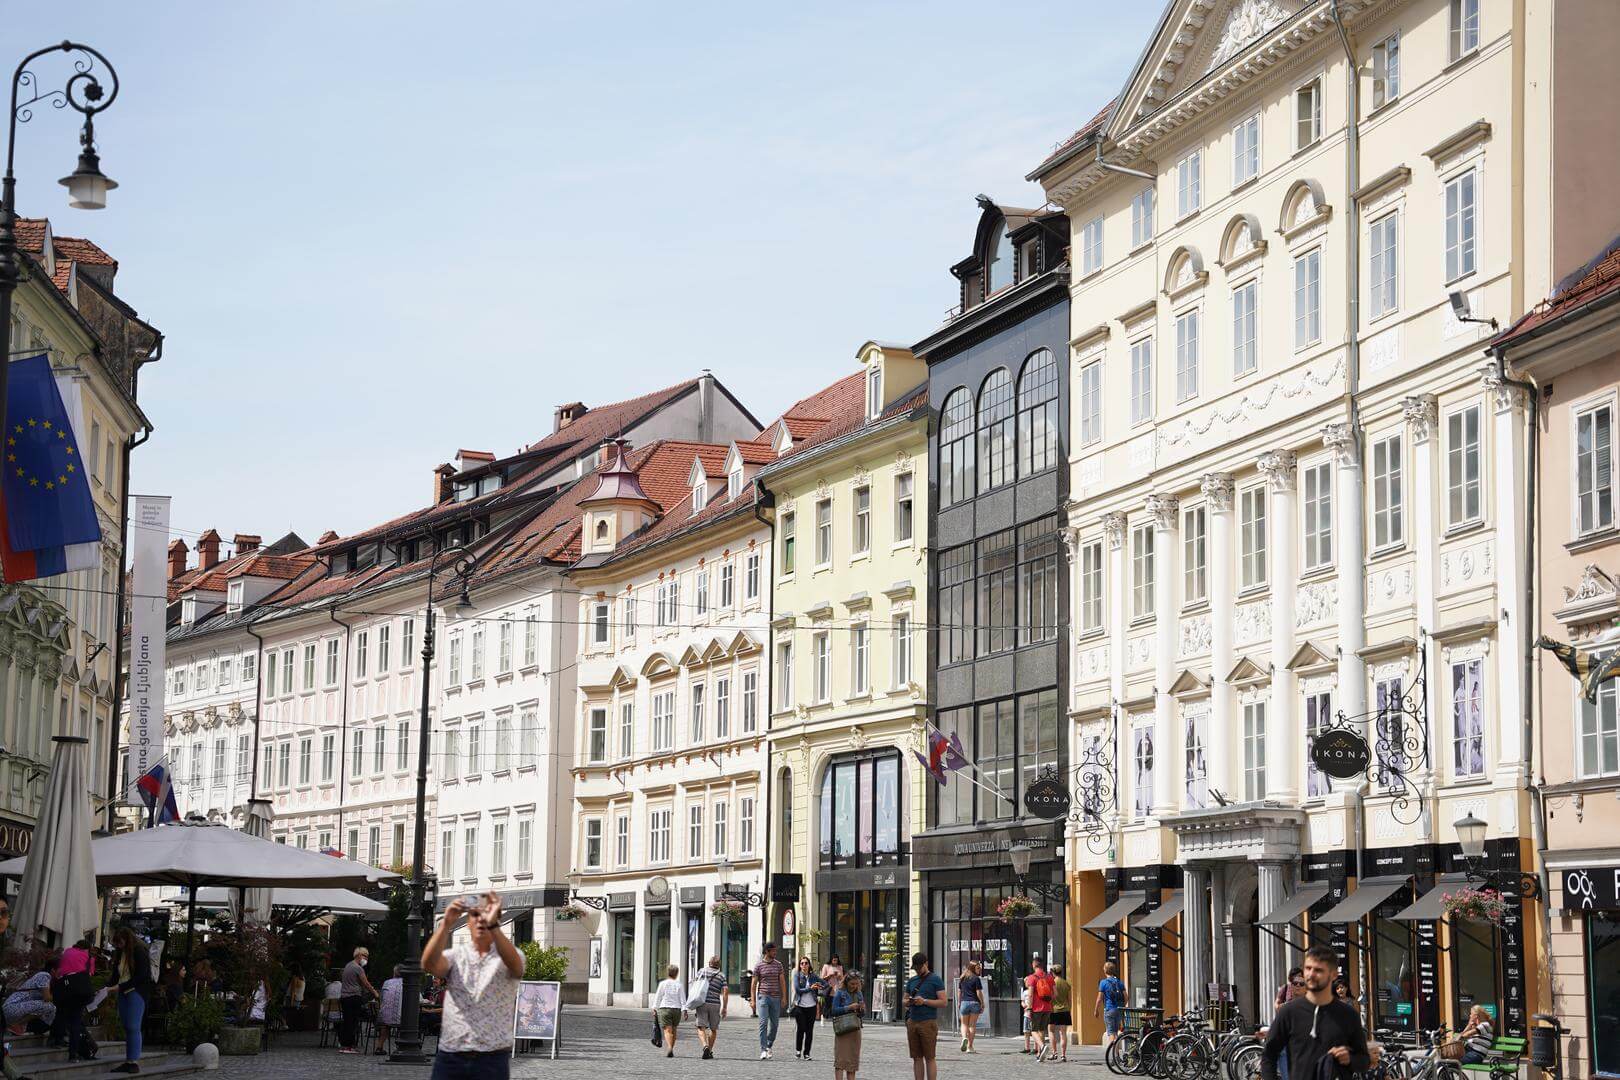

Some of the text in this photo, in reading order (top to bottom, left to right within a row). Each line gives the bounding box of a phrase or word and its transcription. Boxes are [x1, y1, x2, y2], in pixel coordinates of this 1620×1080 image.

[137, 635, 151, 693] Ljubljana
[136, 697, 151, 747] galerija
[1315, 750, 1368, 759] IKONA
